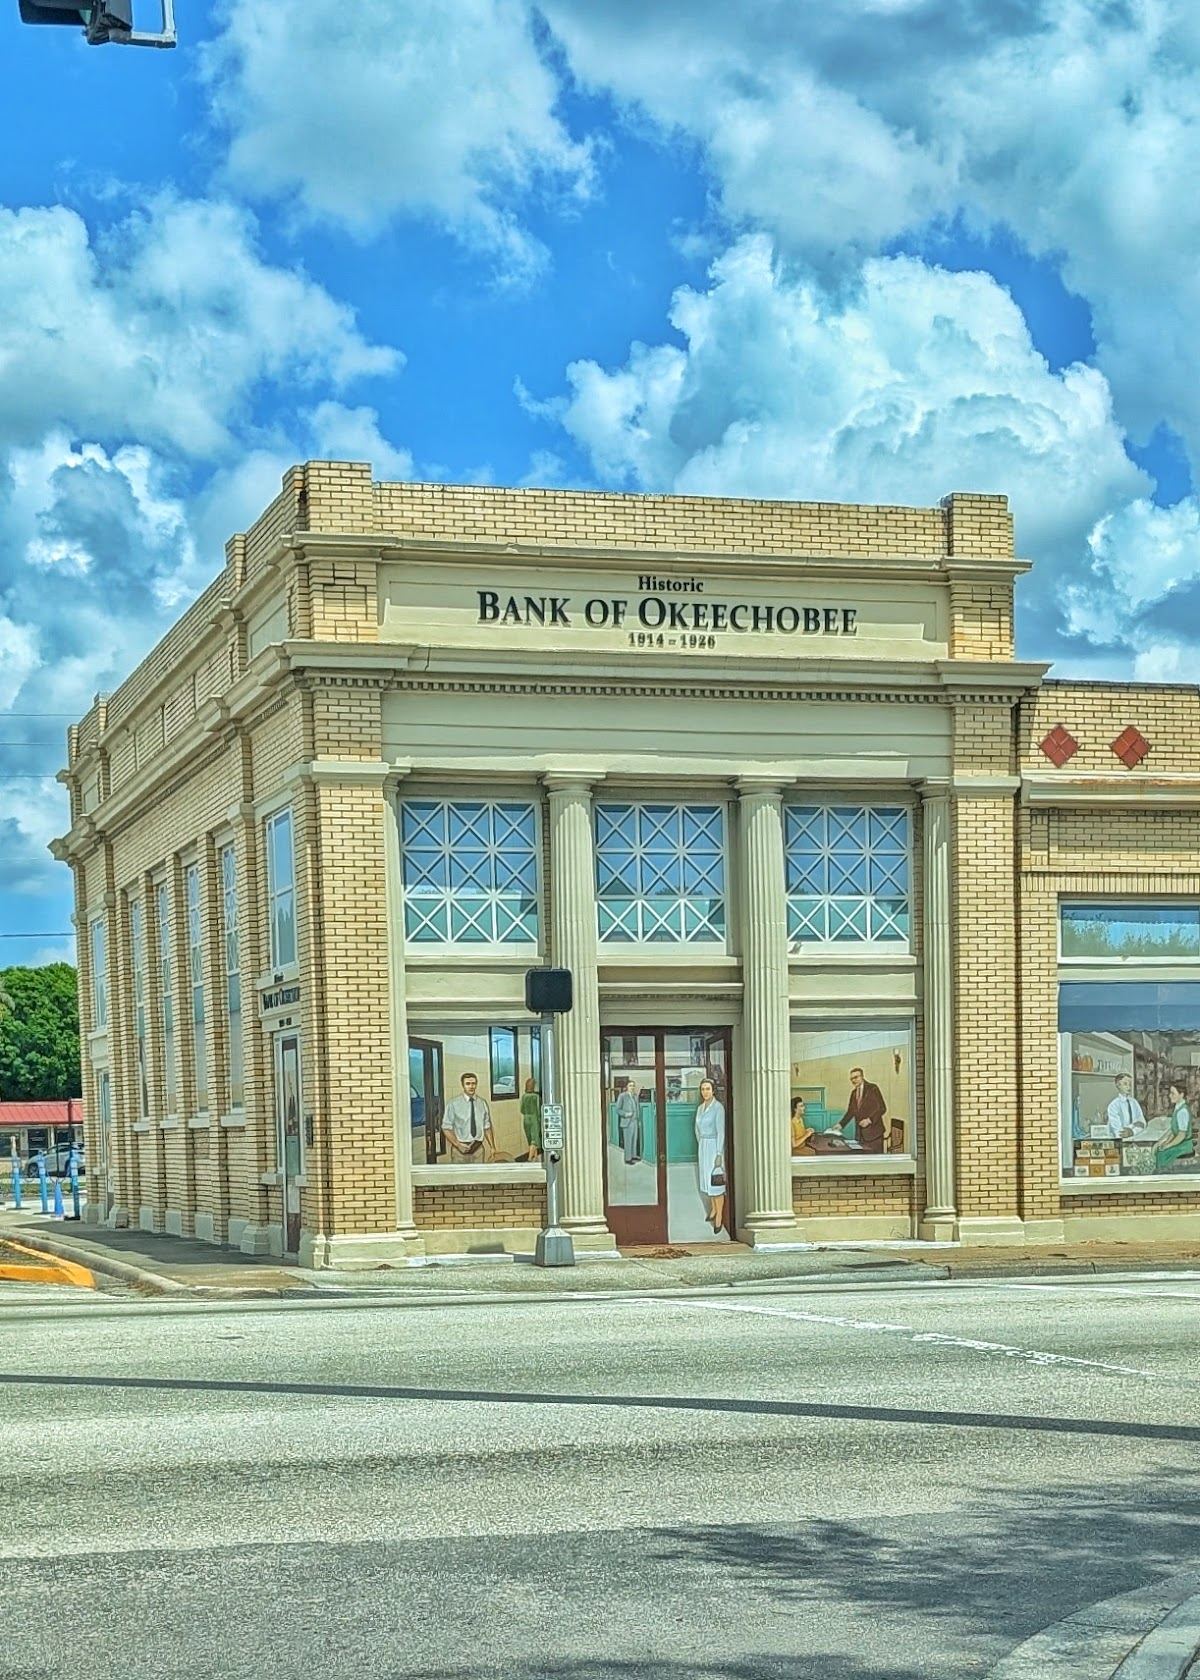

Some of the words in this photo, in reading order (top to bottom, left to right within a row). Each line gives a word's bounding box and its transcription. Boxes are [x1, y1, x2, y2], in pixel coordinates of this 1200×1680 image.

[638, 576, 704, 592] Historic
[477, 591, 572, 626] BANK
[585, 599, 628, 628] OF
[638, 597, 858, 634] OKEECHOBEE
